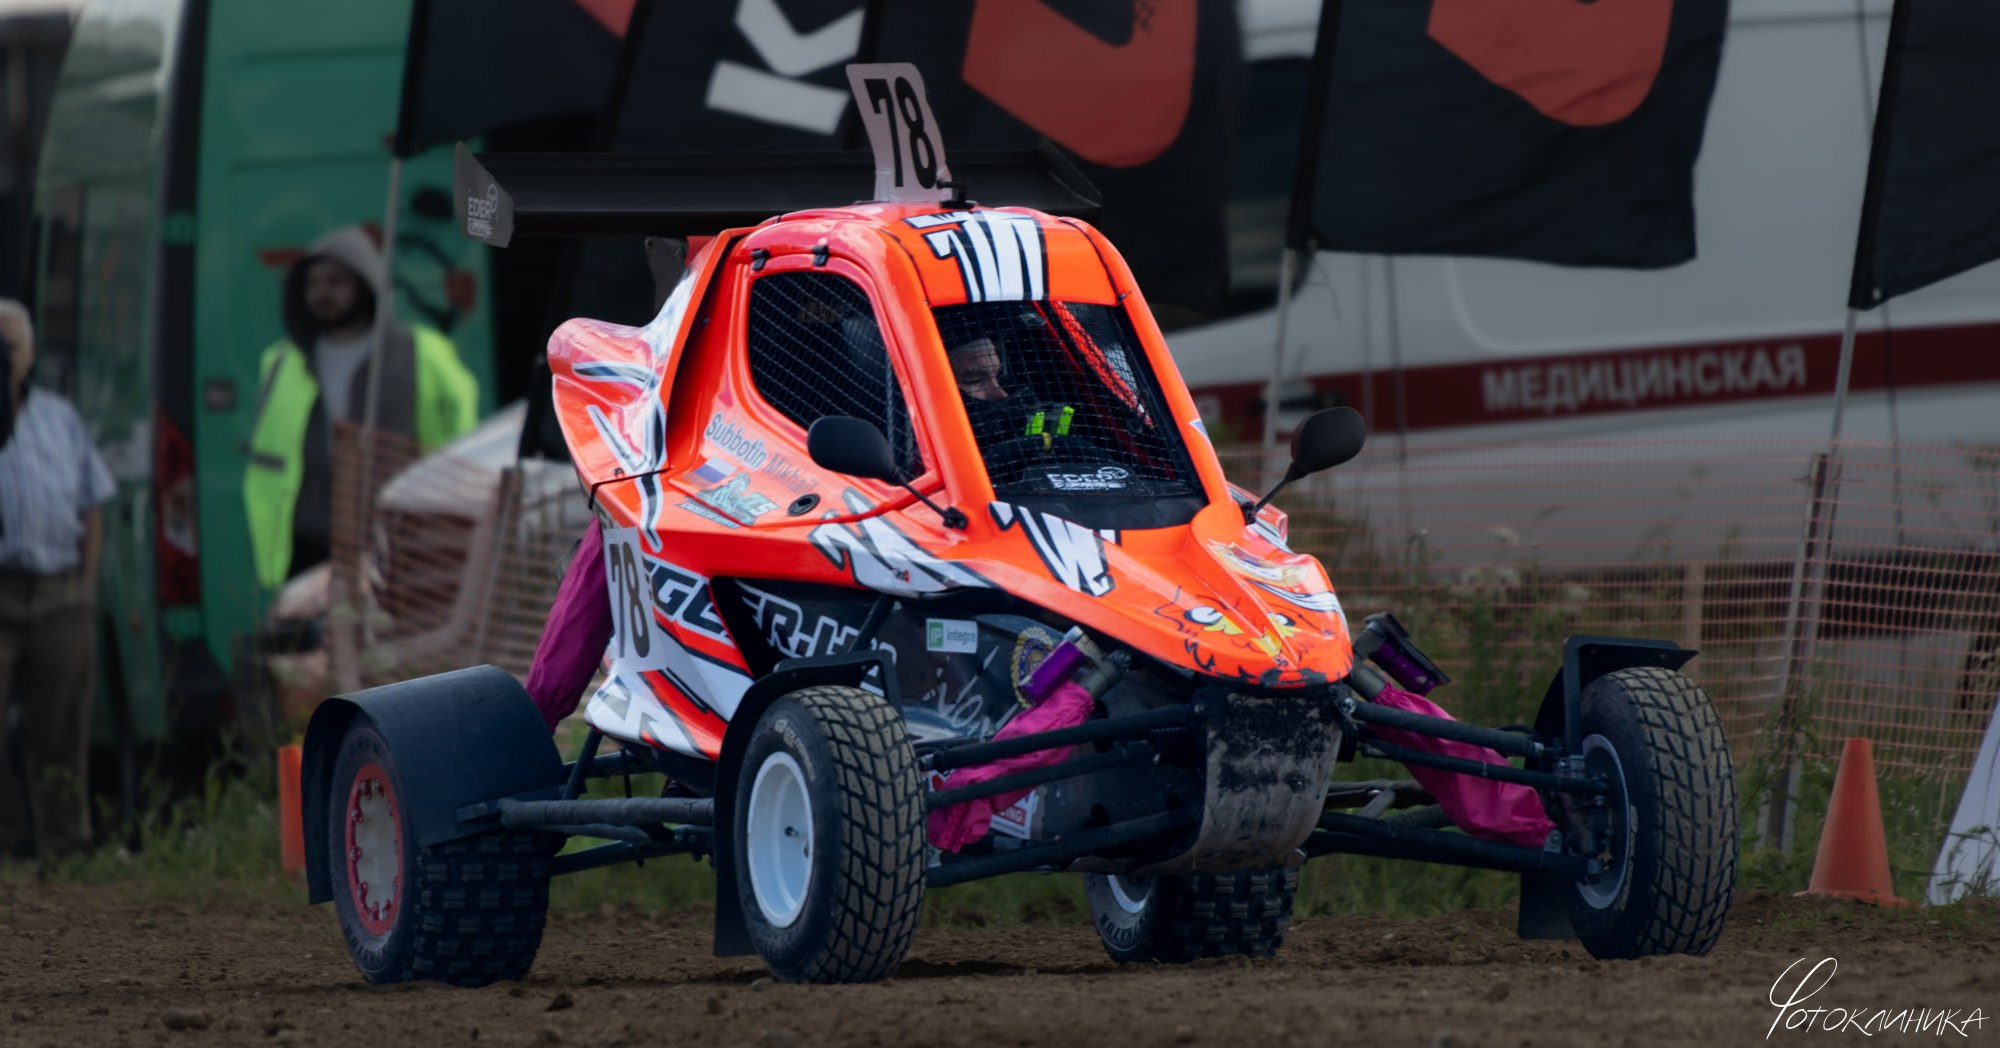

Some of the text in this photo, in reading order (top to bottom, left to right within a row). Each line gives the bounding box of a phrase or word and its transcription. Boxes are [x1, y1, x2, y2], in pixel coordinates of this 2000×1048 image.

[863, 76, 937, 189] 78
[468, 197, 492, 219] EDER
[1482, 345, 1807, 414] МЕДИЦИНСКАЯ
[704, 411, 767, 468] Subbotin
[608, 541, 651, 658] 78
